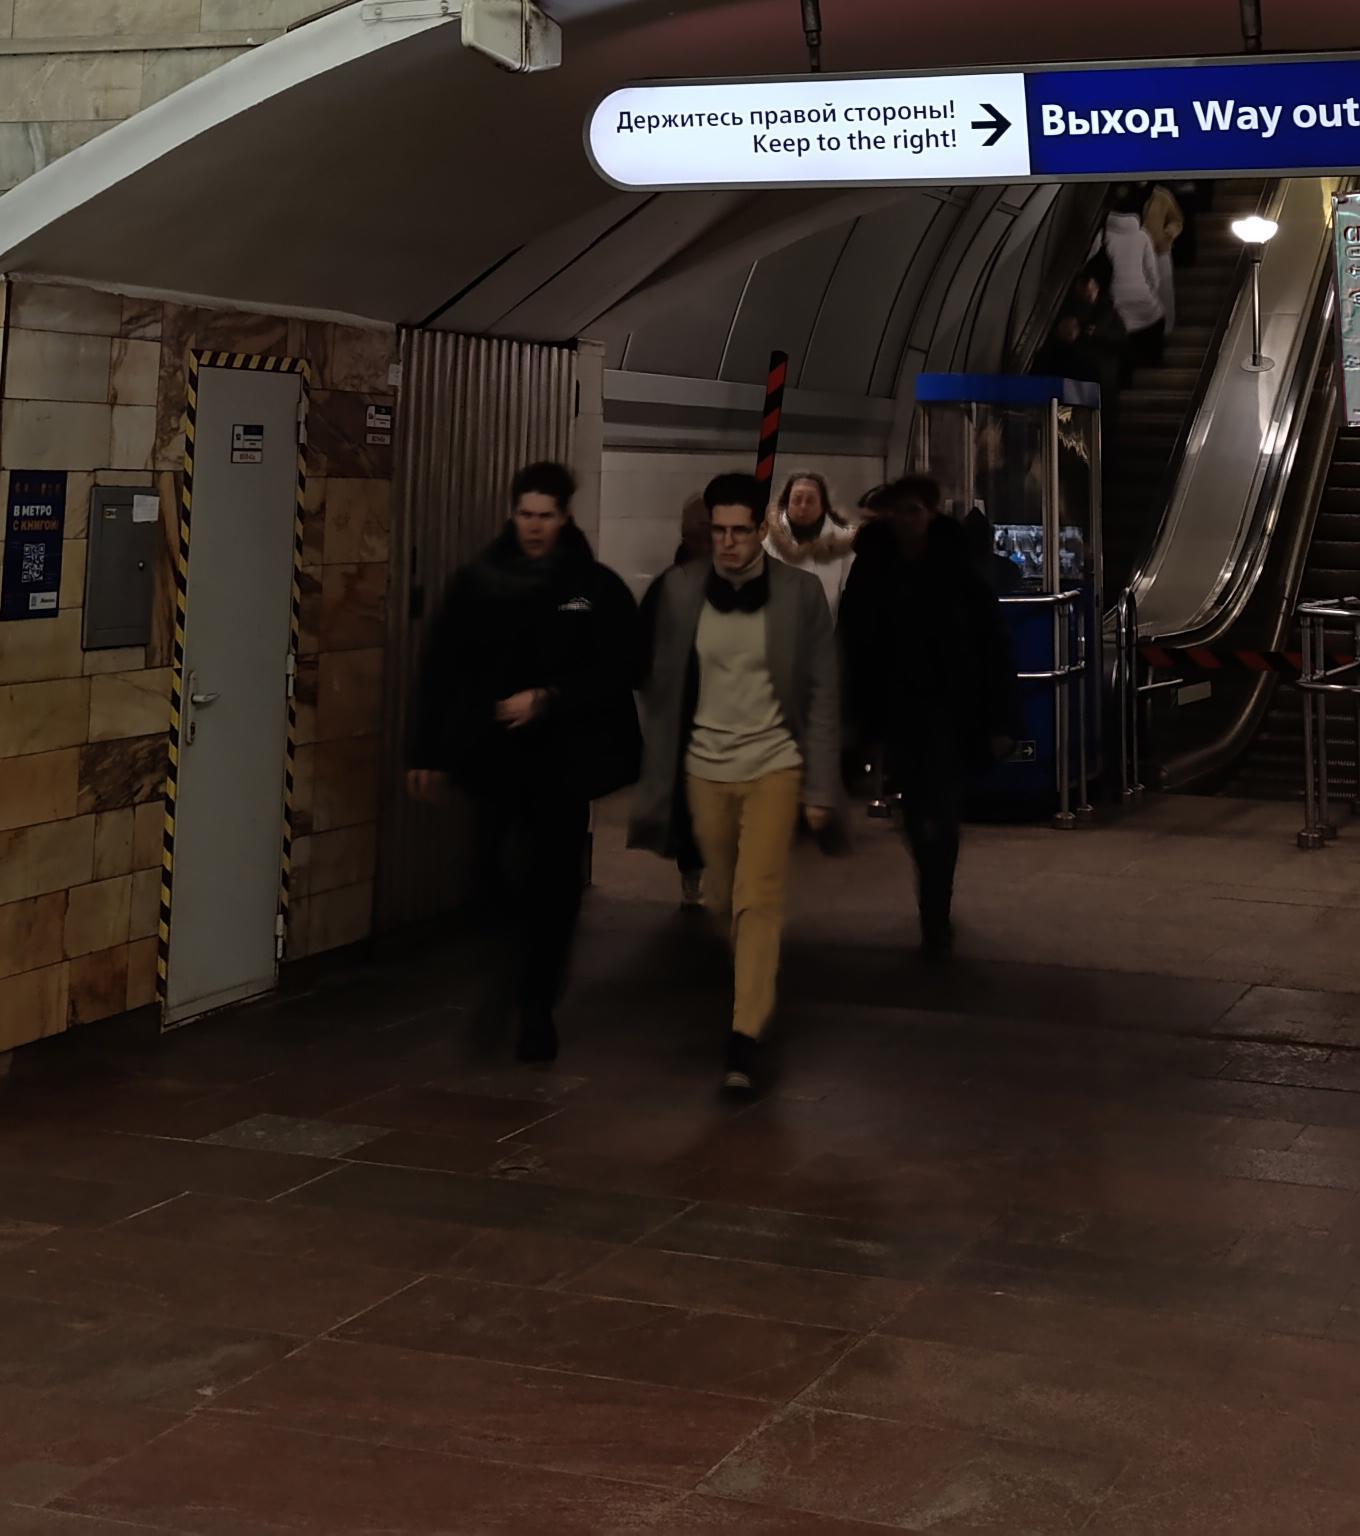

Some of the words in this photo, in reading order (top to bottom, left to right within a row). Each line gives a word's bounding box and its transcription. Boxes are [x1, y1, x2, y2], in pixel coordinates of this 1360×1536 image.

[617, 111, 743, 134] Держитесь
[750, 103, 836, 130] правой
[844, 100, 954, 126] стороны!
[1042, 104, 1179, 138] Выход
[1193, 100, 1282, 138] Way
[1293, 98, 1360, 128] out
[753, 134, 810, 157] Keep
[816, 134, 840, 151] to
[847, 130, 885, 150] the
[893, 128, 956, 154] right!
[14, 505, 20, 516] В
[22, 505, 52, 516] МЕТРО
